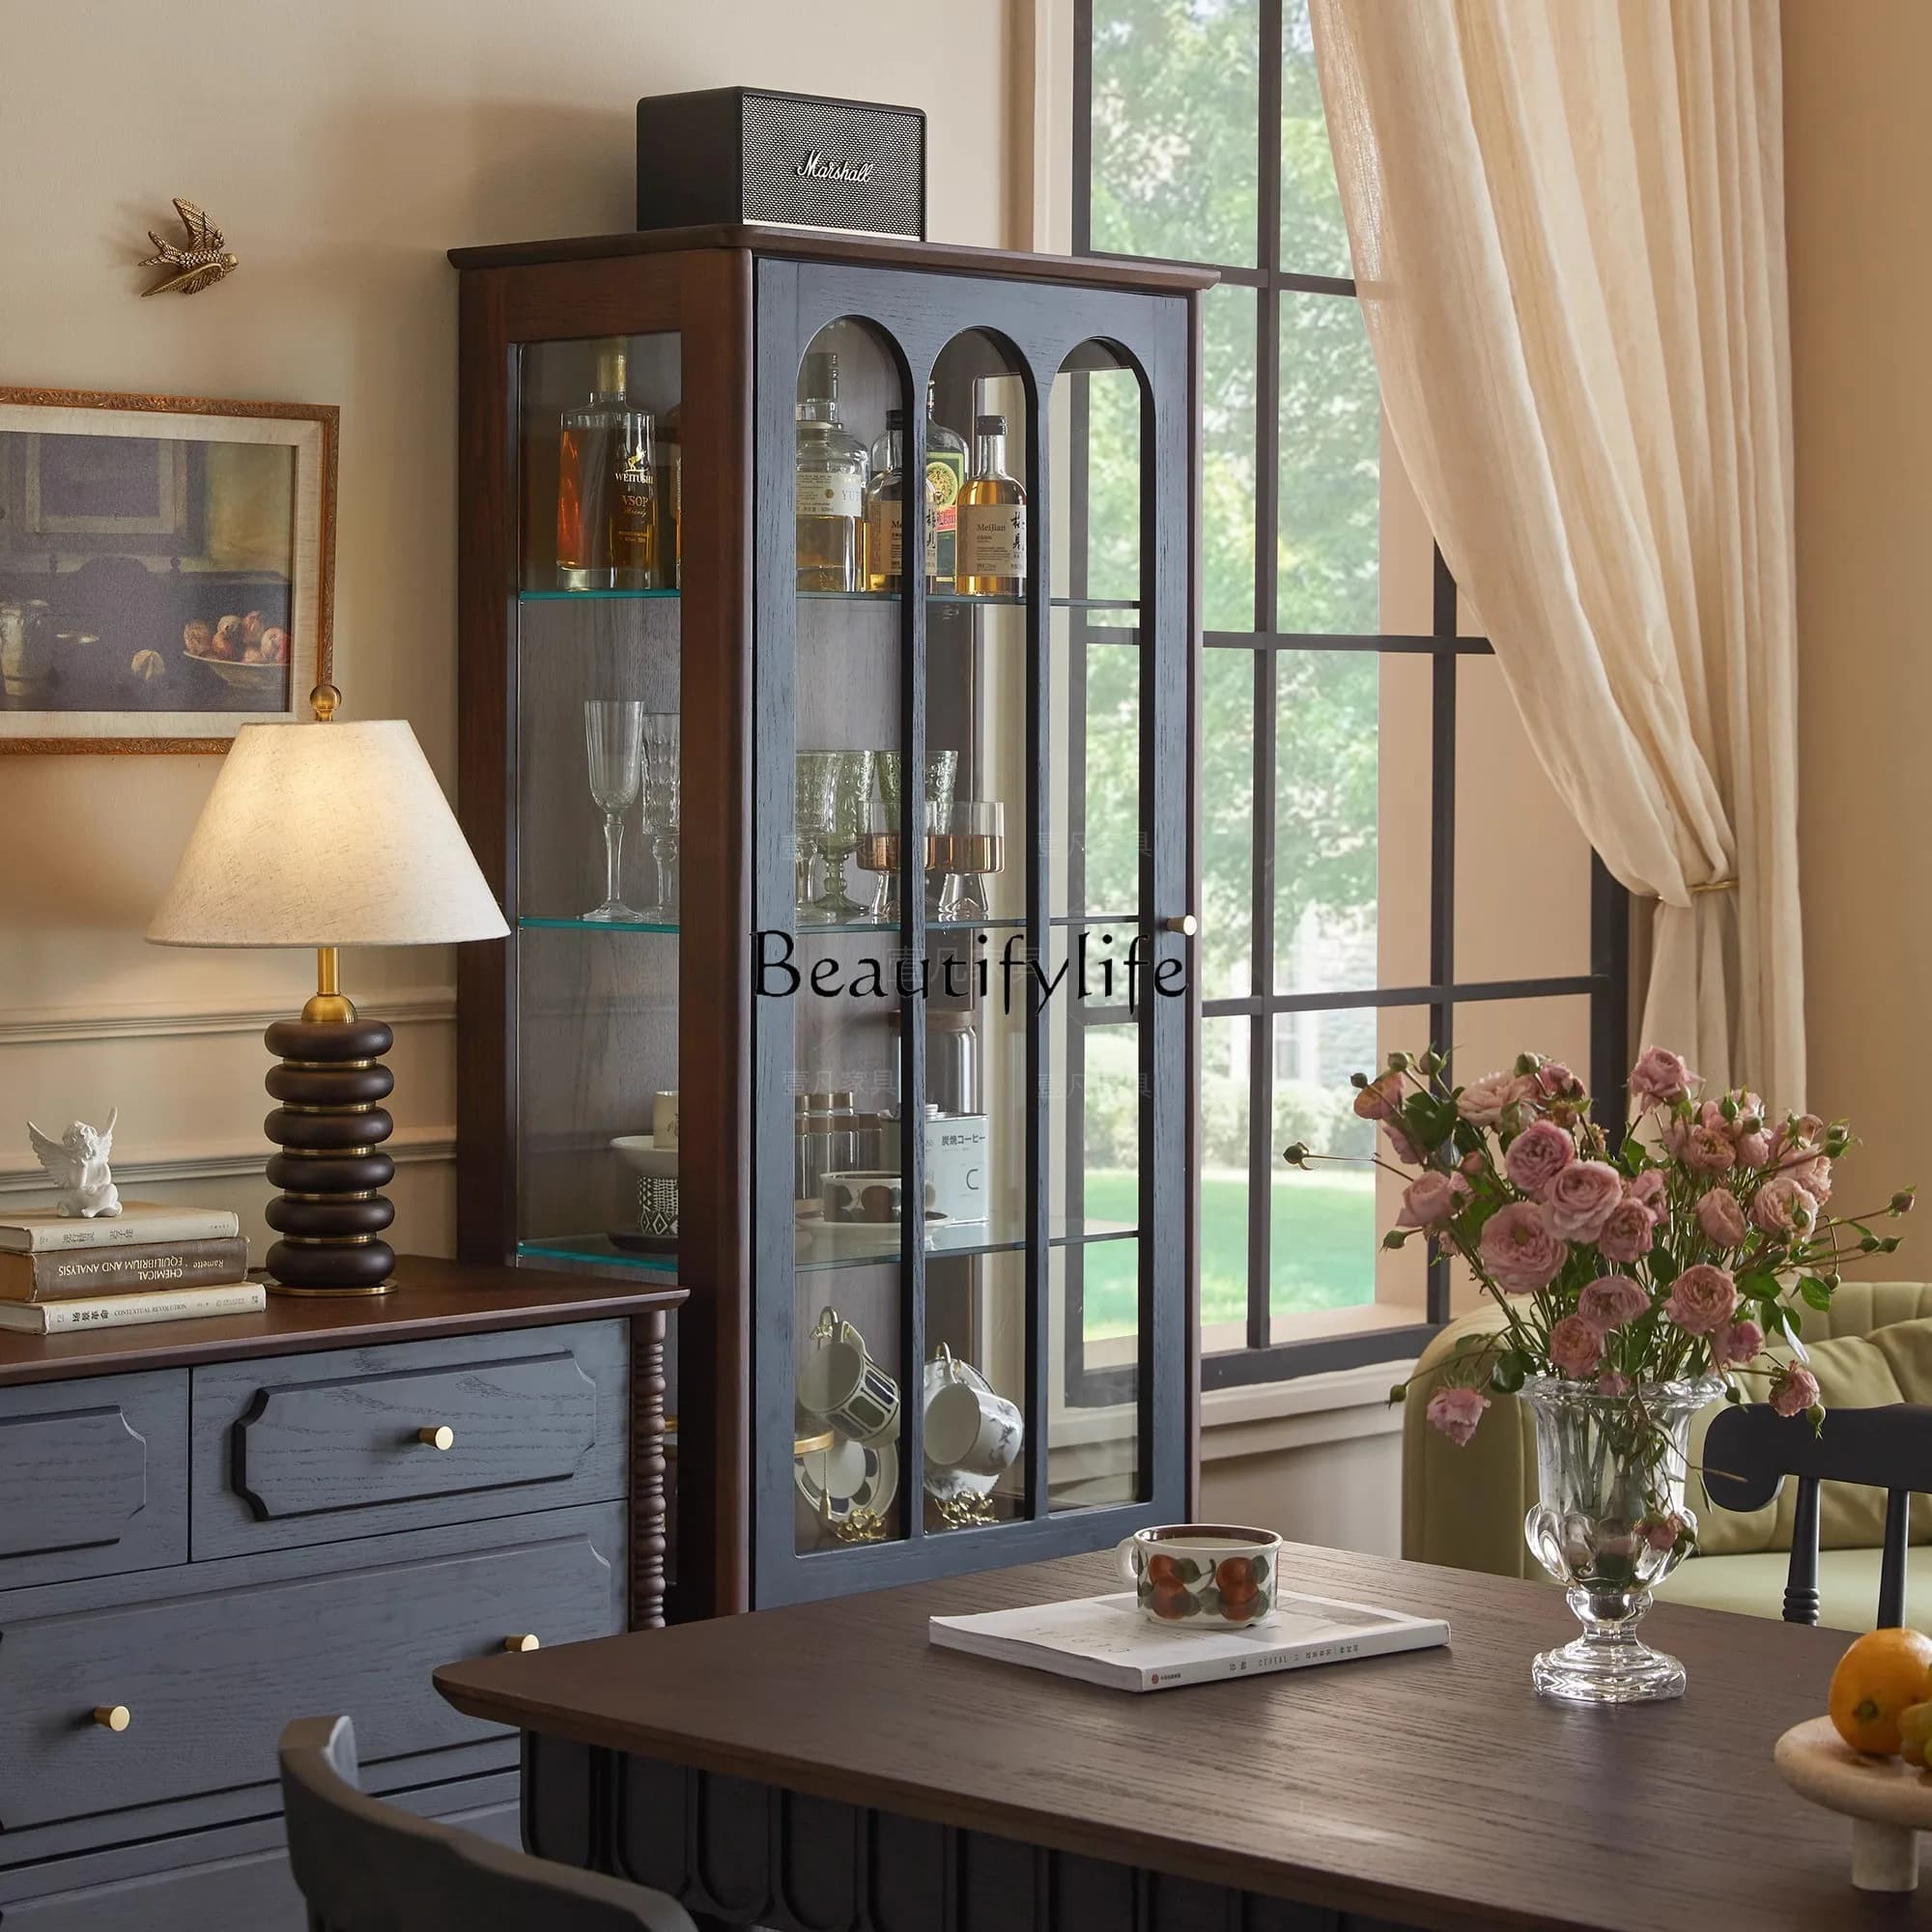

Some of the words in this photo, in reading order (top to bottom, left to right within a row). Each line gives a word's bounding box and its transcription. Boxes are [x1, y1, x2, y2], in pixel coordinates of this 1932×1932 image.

[797, 149, 874, 182] Marshall
[621, 495, 648, 507] VSOP
[101, 1262, 122, 1272] AND
[125, 1256, 183, 1271] EQUILIBRIUM
[193, 1259, 224, 1268] Ramette
[58, 1264, 99, 1277] ANALYSIS
[138, 1267, 183, 1281] CHEMICAL
